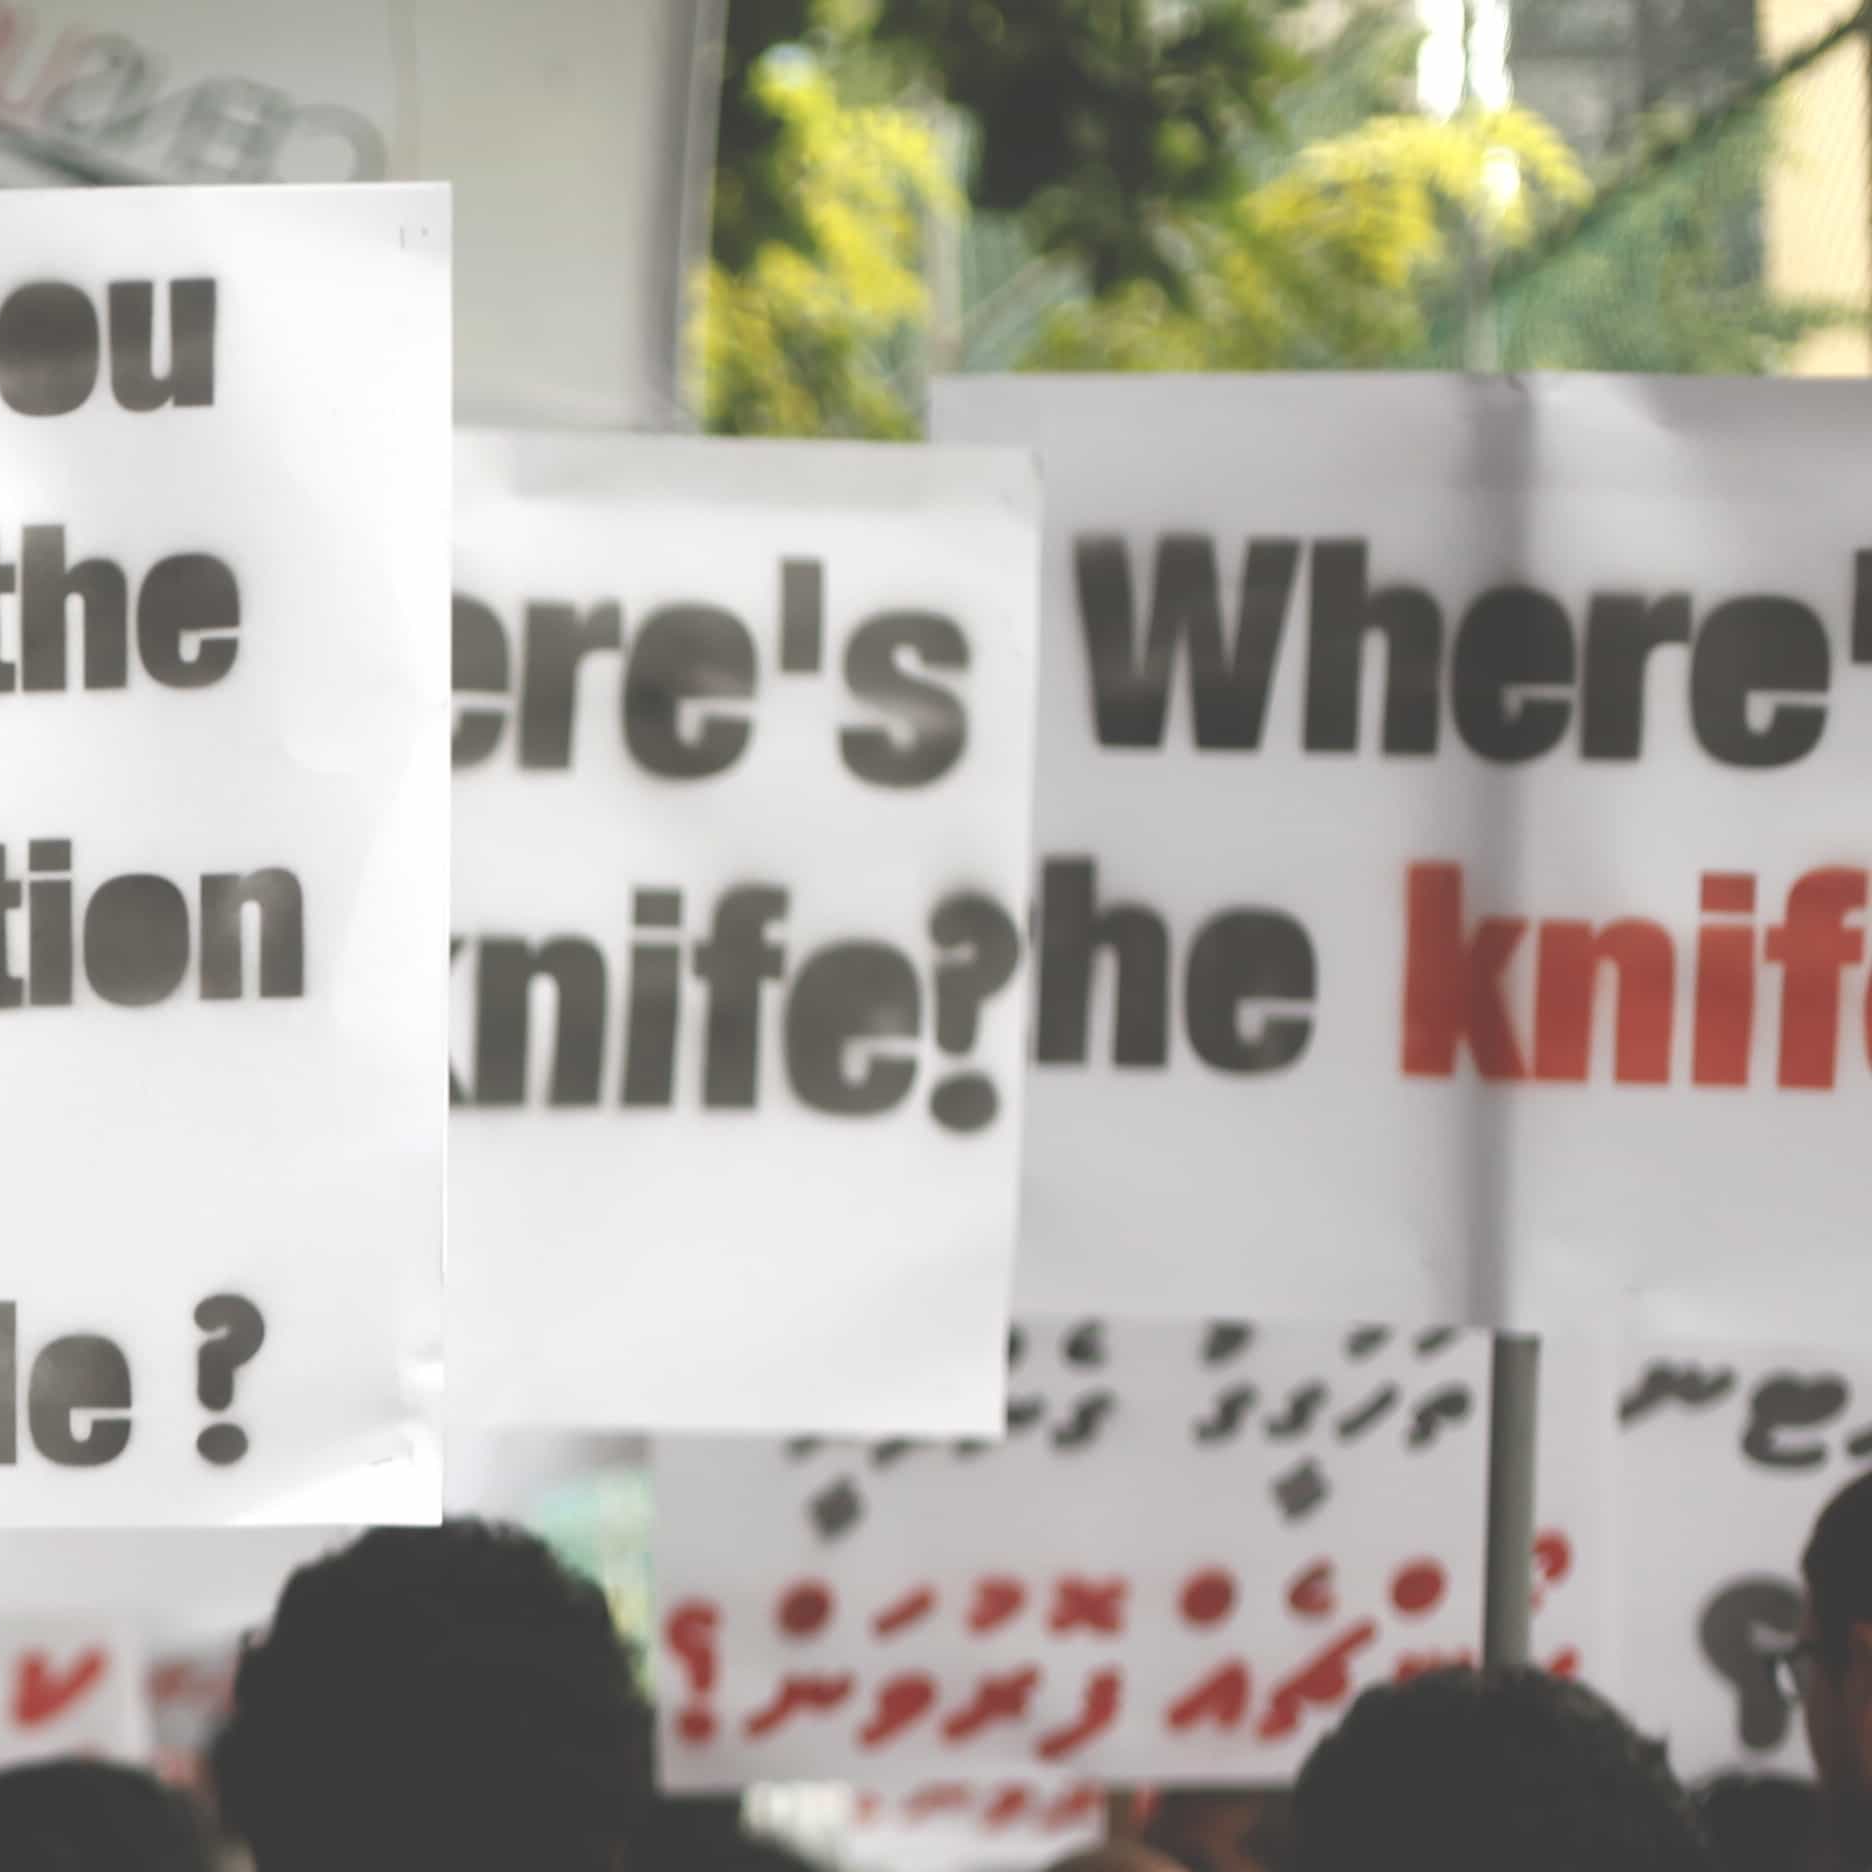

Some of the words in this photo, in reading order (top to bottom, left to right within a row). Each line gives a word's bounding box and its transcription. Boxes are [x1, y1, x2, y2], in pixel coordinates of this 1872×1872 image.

[450, 558, 970, 790] ere's
[1074, 533, 1872, 768] Where'
[450, 883, 1023, 1138] nife?
[1030, 855, 1320, 1076] he
[1399, 860, 1872, 1090] knif
